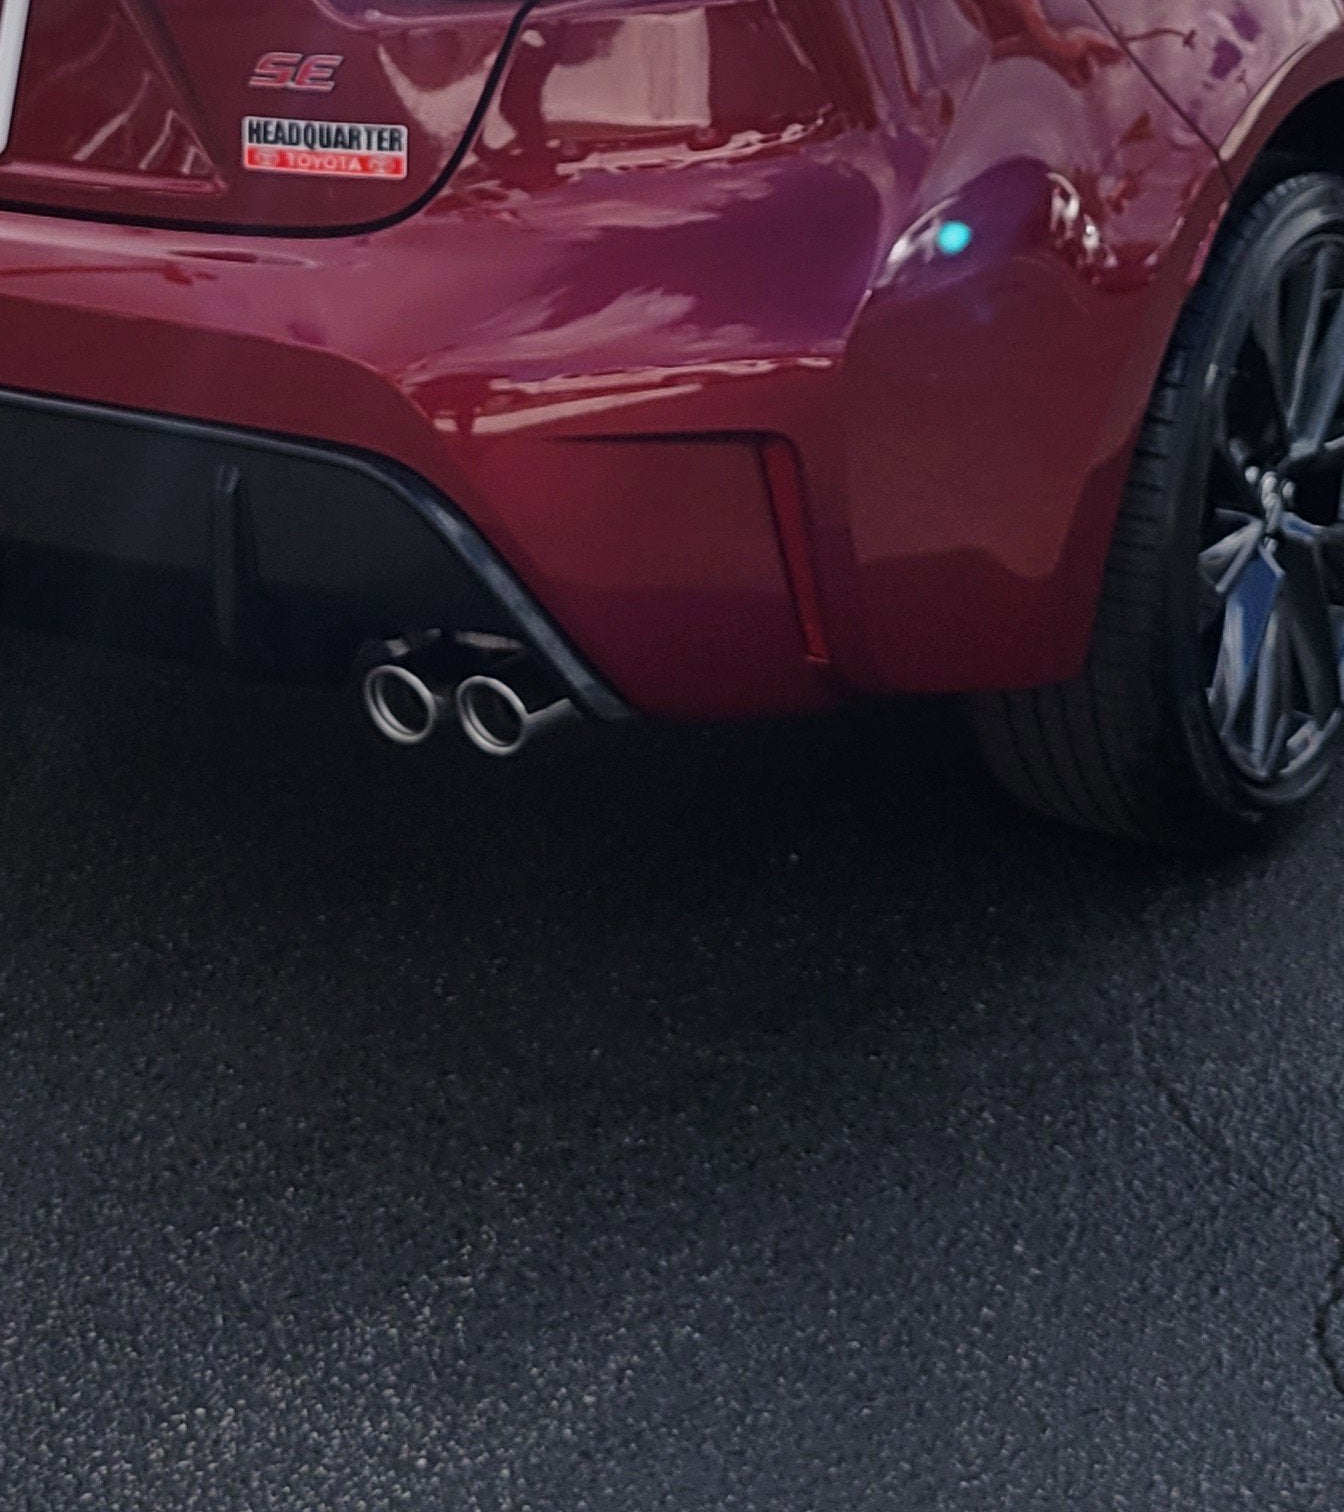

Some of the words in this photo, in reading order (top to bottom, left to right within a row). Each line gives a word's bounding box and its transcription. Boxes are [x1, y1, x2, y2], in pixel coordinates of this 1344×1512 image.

[248, 51, 344, 92] SE
[247, 118, 403, 152] HEADQUARTER
[287, 153, 362, 171] TOYOTA
